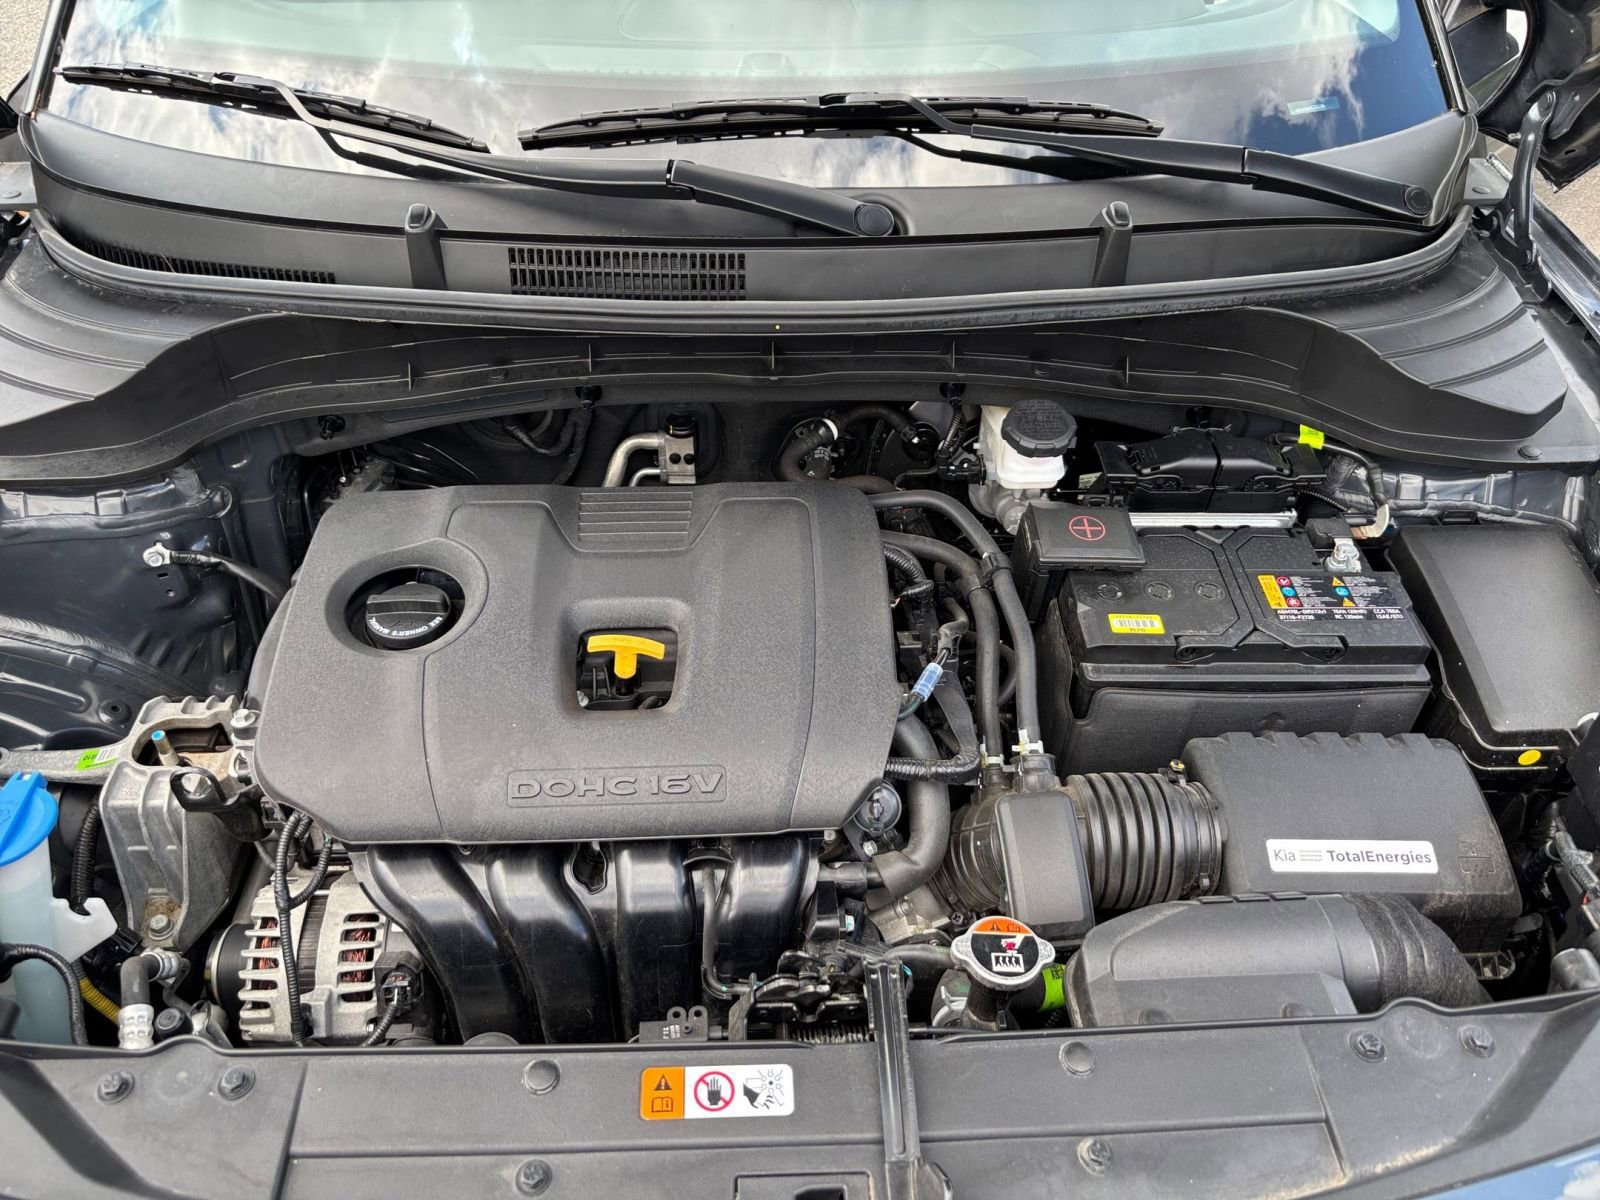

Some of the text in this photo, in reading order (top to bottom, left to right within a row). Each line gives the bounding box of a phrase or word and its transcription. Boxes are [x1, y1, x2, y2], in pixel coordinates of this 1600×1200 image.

[368, 616, 443, 636] SEE OWNER'S MANUAL
[511, 773, 723, 799] DOHC 16V
[1273, 848, 1297, 862] Kia
[1326, 849, 1432, 865] TotalEnergies
